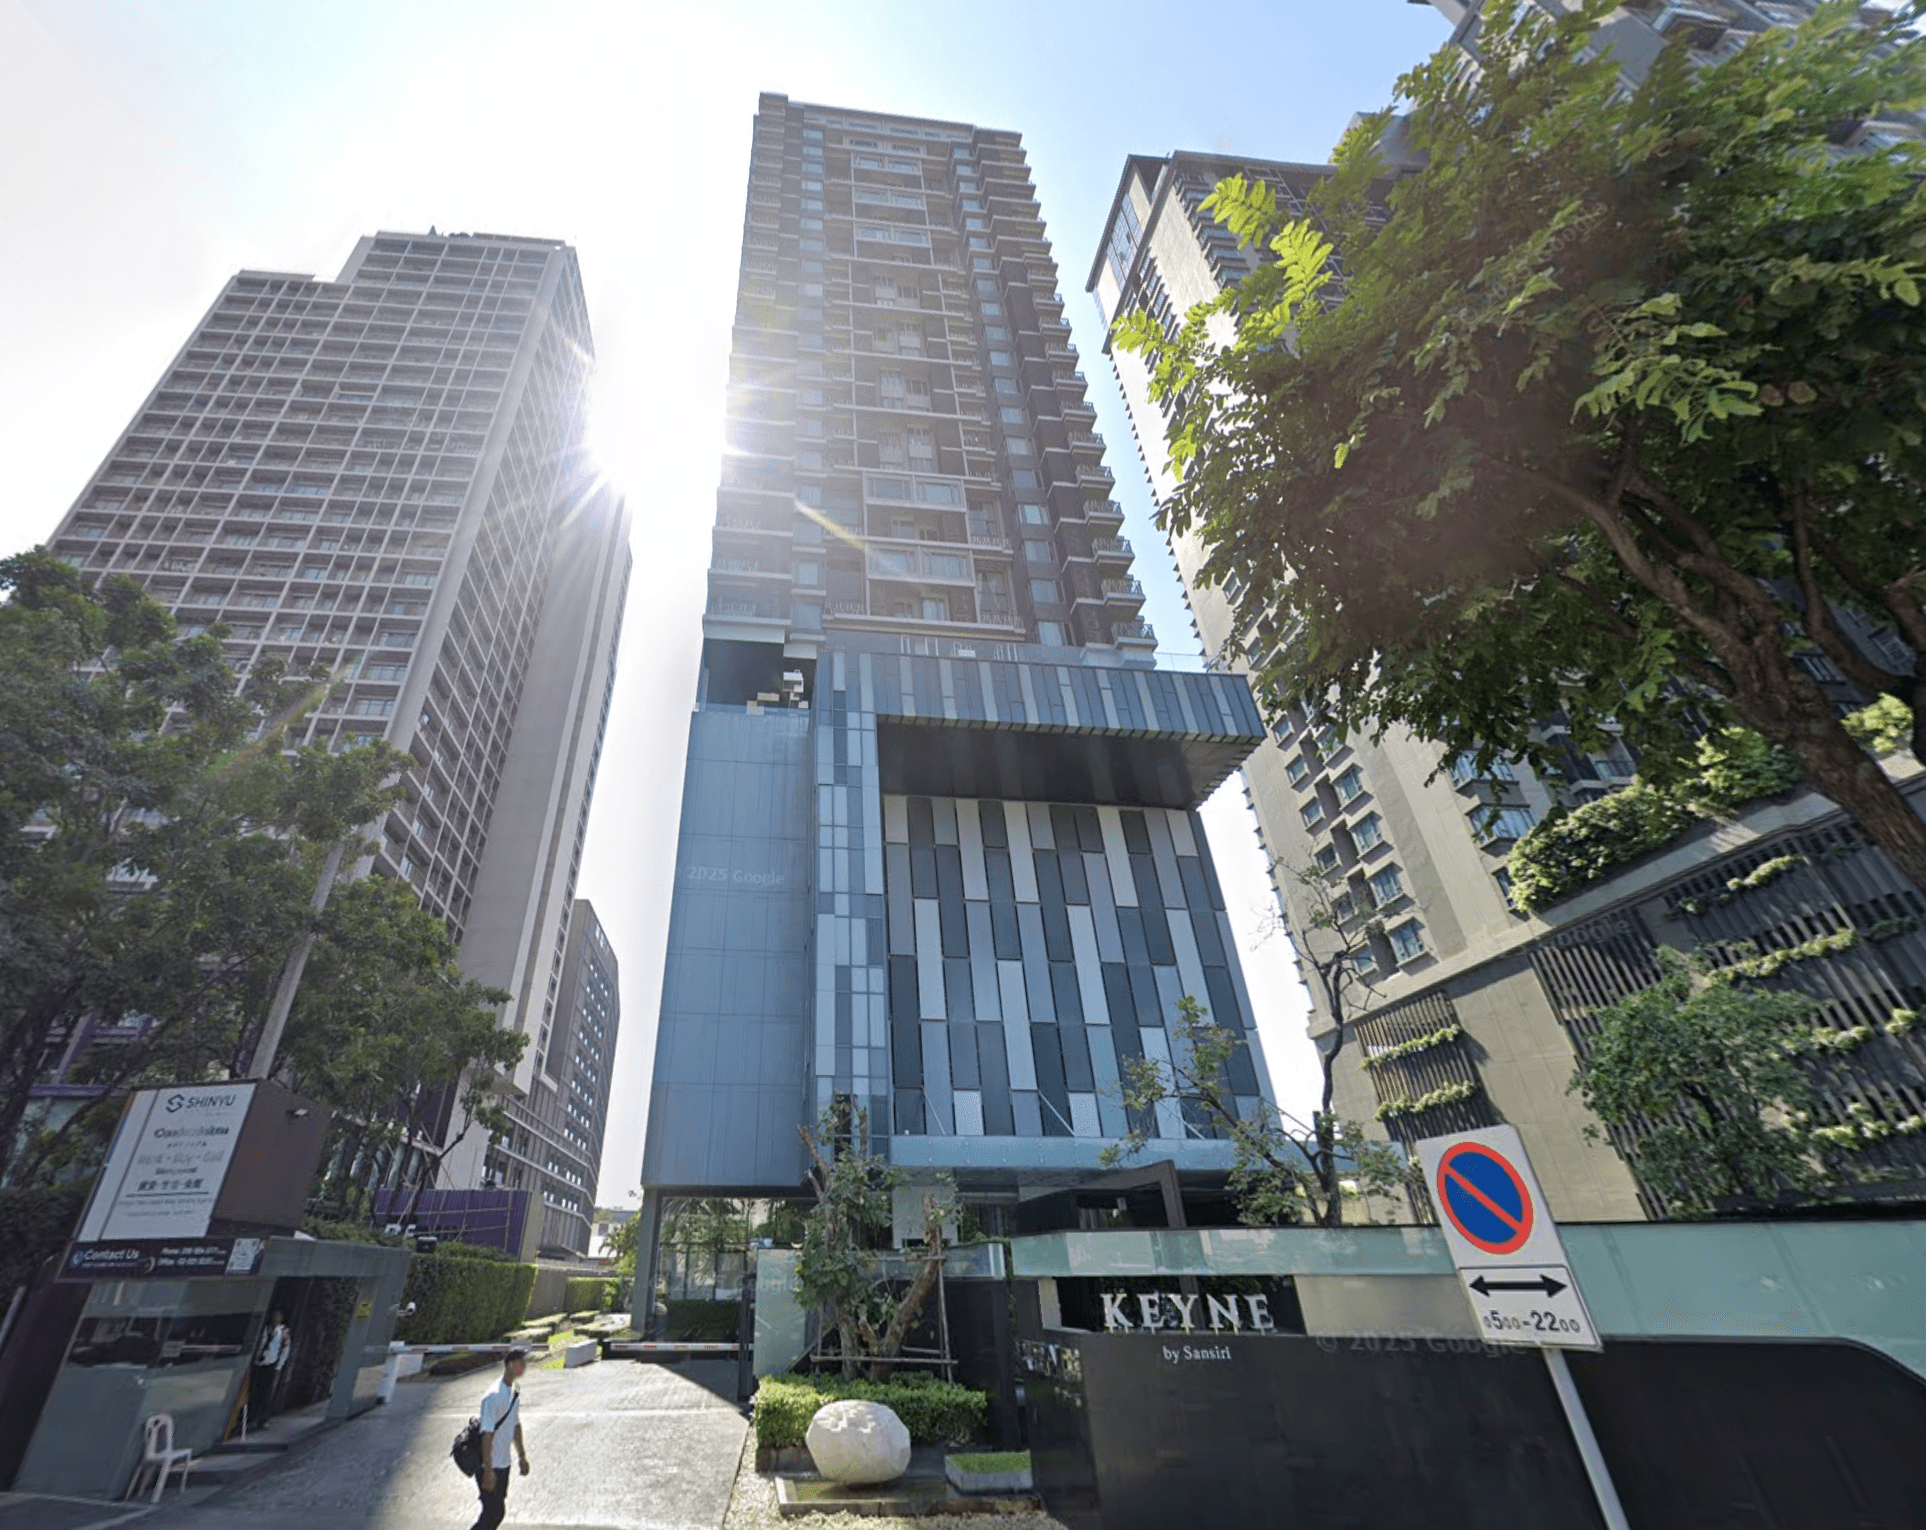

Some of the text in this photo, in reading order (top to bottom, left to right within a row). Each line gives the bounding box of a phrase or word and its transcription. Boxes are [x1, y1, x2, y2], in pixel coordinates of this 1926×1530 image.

[185, 1094, 237, 1109] SHINYU
[83, 1248, 140, 1261] Contact Us
[1099, 1292, 1276, 1331] KEYNE
[1163, 1345, 1232, 1364] by Sansiri
